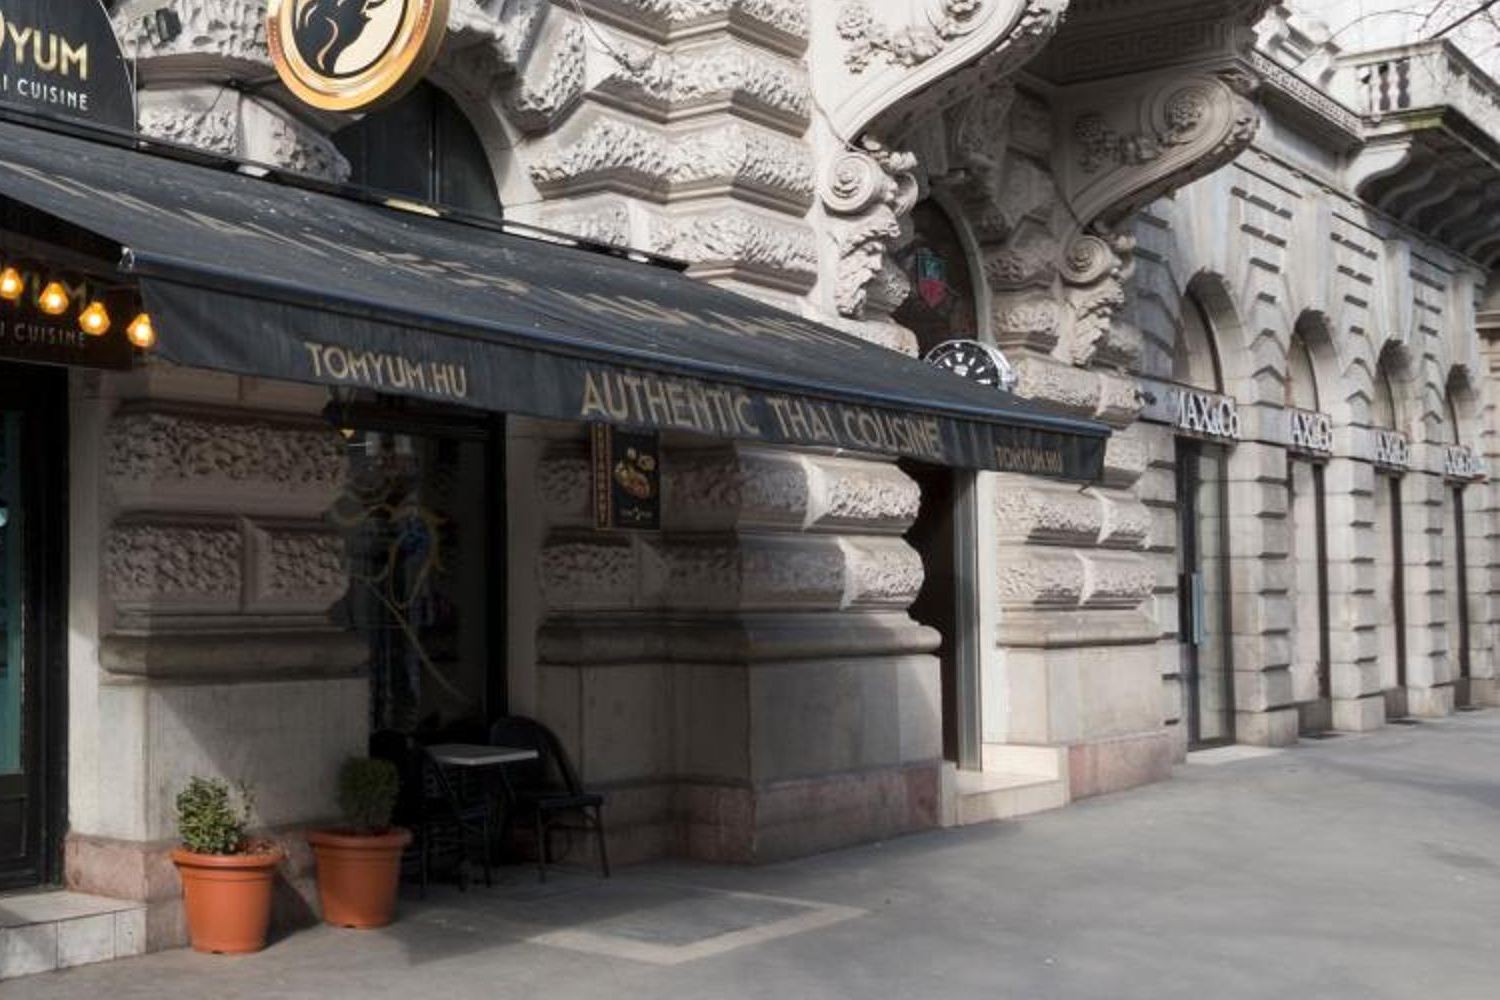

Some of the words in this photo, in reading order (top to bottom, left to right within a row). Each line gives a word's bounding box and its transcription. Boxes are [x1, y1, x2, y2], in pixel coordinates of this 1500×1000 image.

[6, 23, 88, 81] YUM
[17, 79, 89, 111] CUISINE
[304, 341, 468, 397] TOMYUM.HU
[580, 371, 762, 435] AUTHENTIC
[767, 396, 841, 442] THAI
